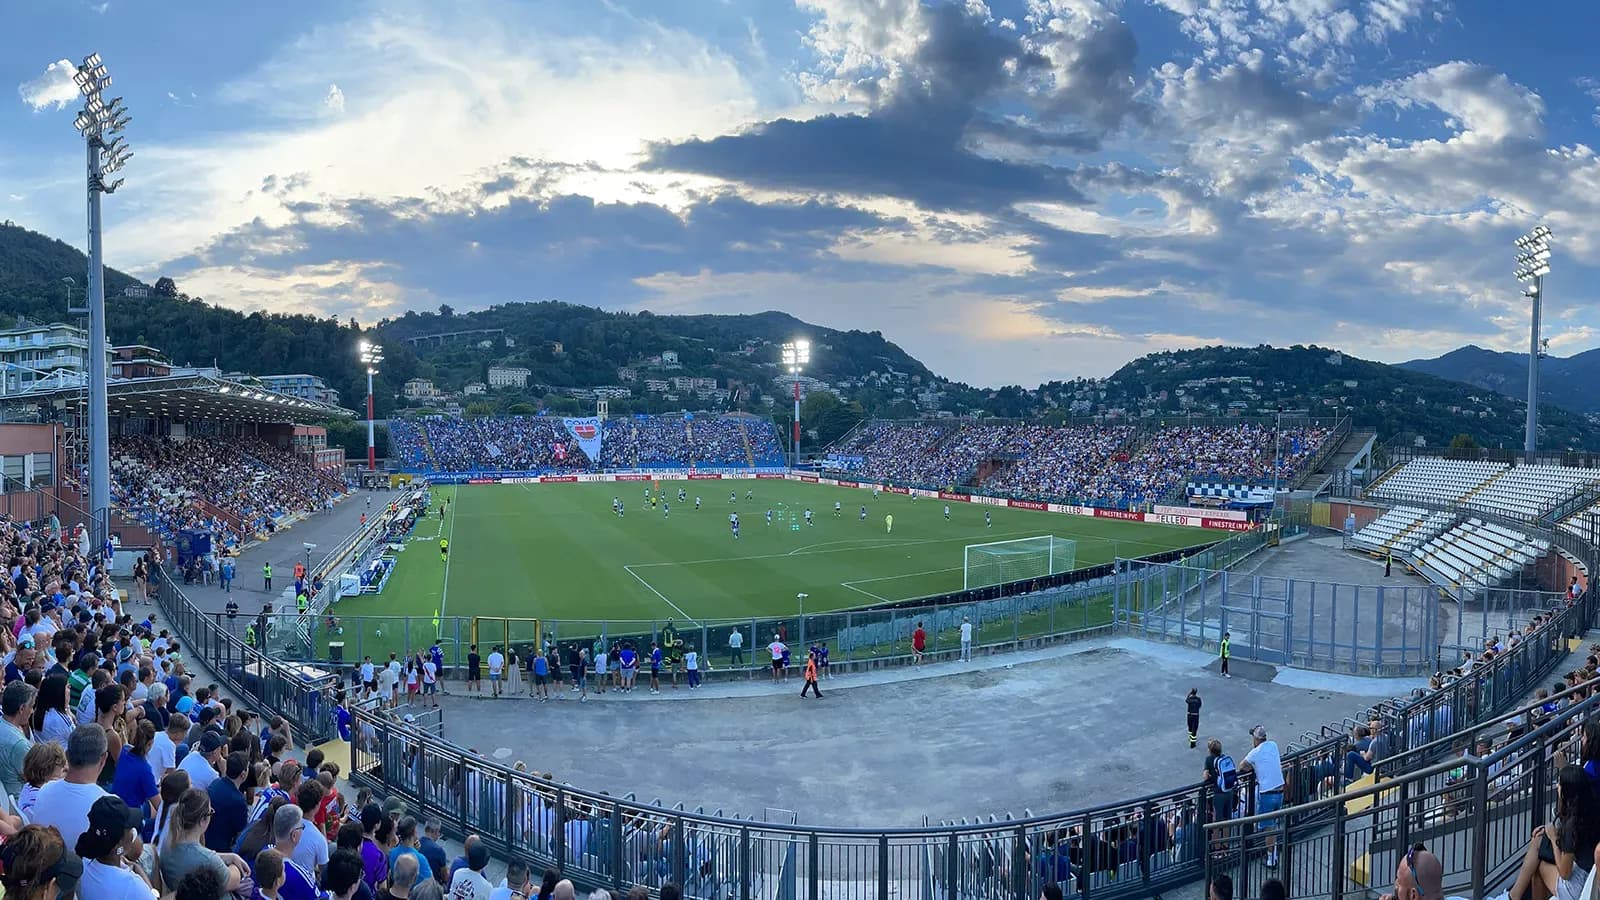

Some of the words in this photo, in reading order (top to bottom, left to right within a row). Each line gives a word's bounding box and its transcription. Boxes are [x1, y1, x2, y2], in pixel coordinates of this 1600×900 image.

[1100, 510, 1122, 518] FINESTRE
[1160, 515, 1188, 525] ELLEDI
[1208, 520, 1236, 529] FINESTRE
